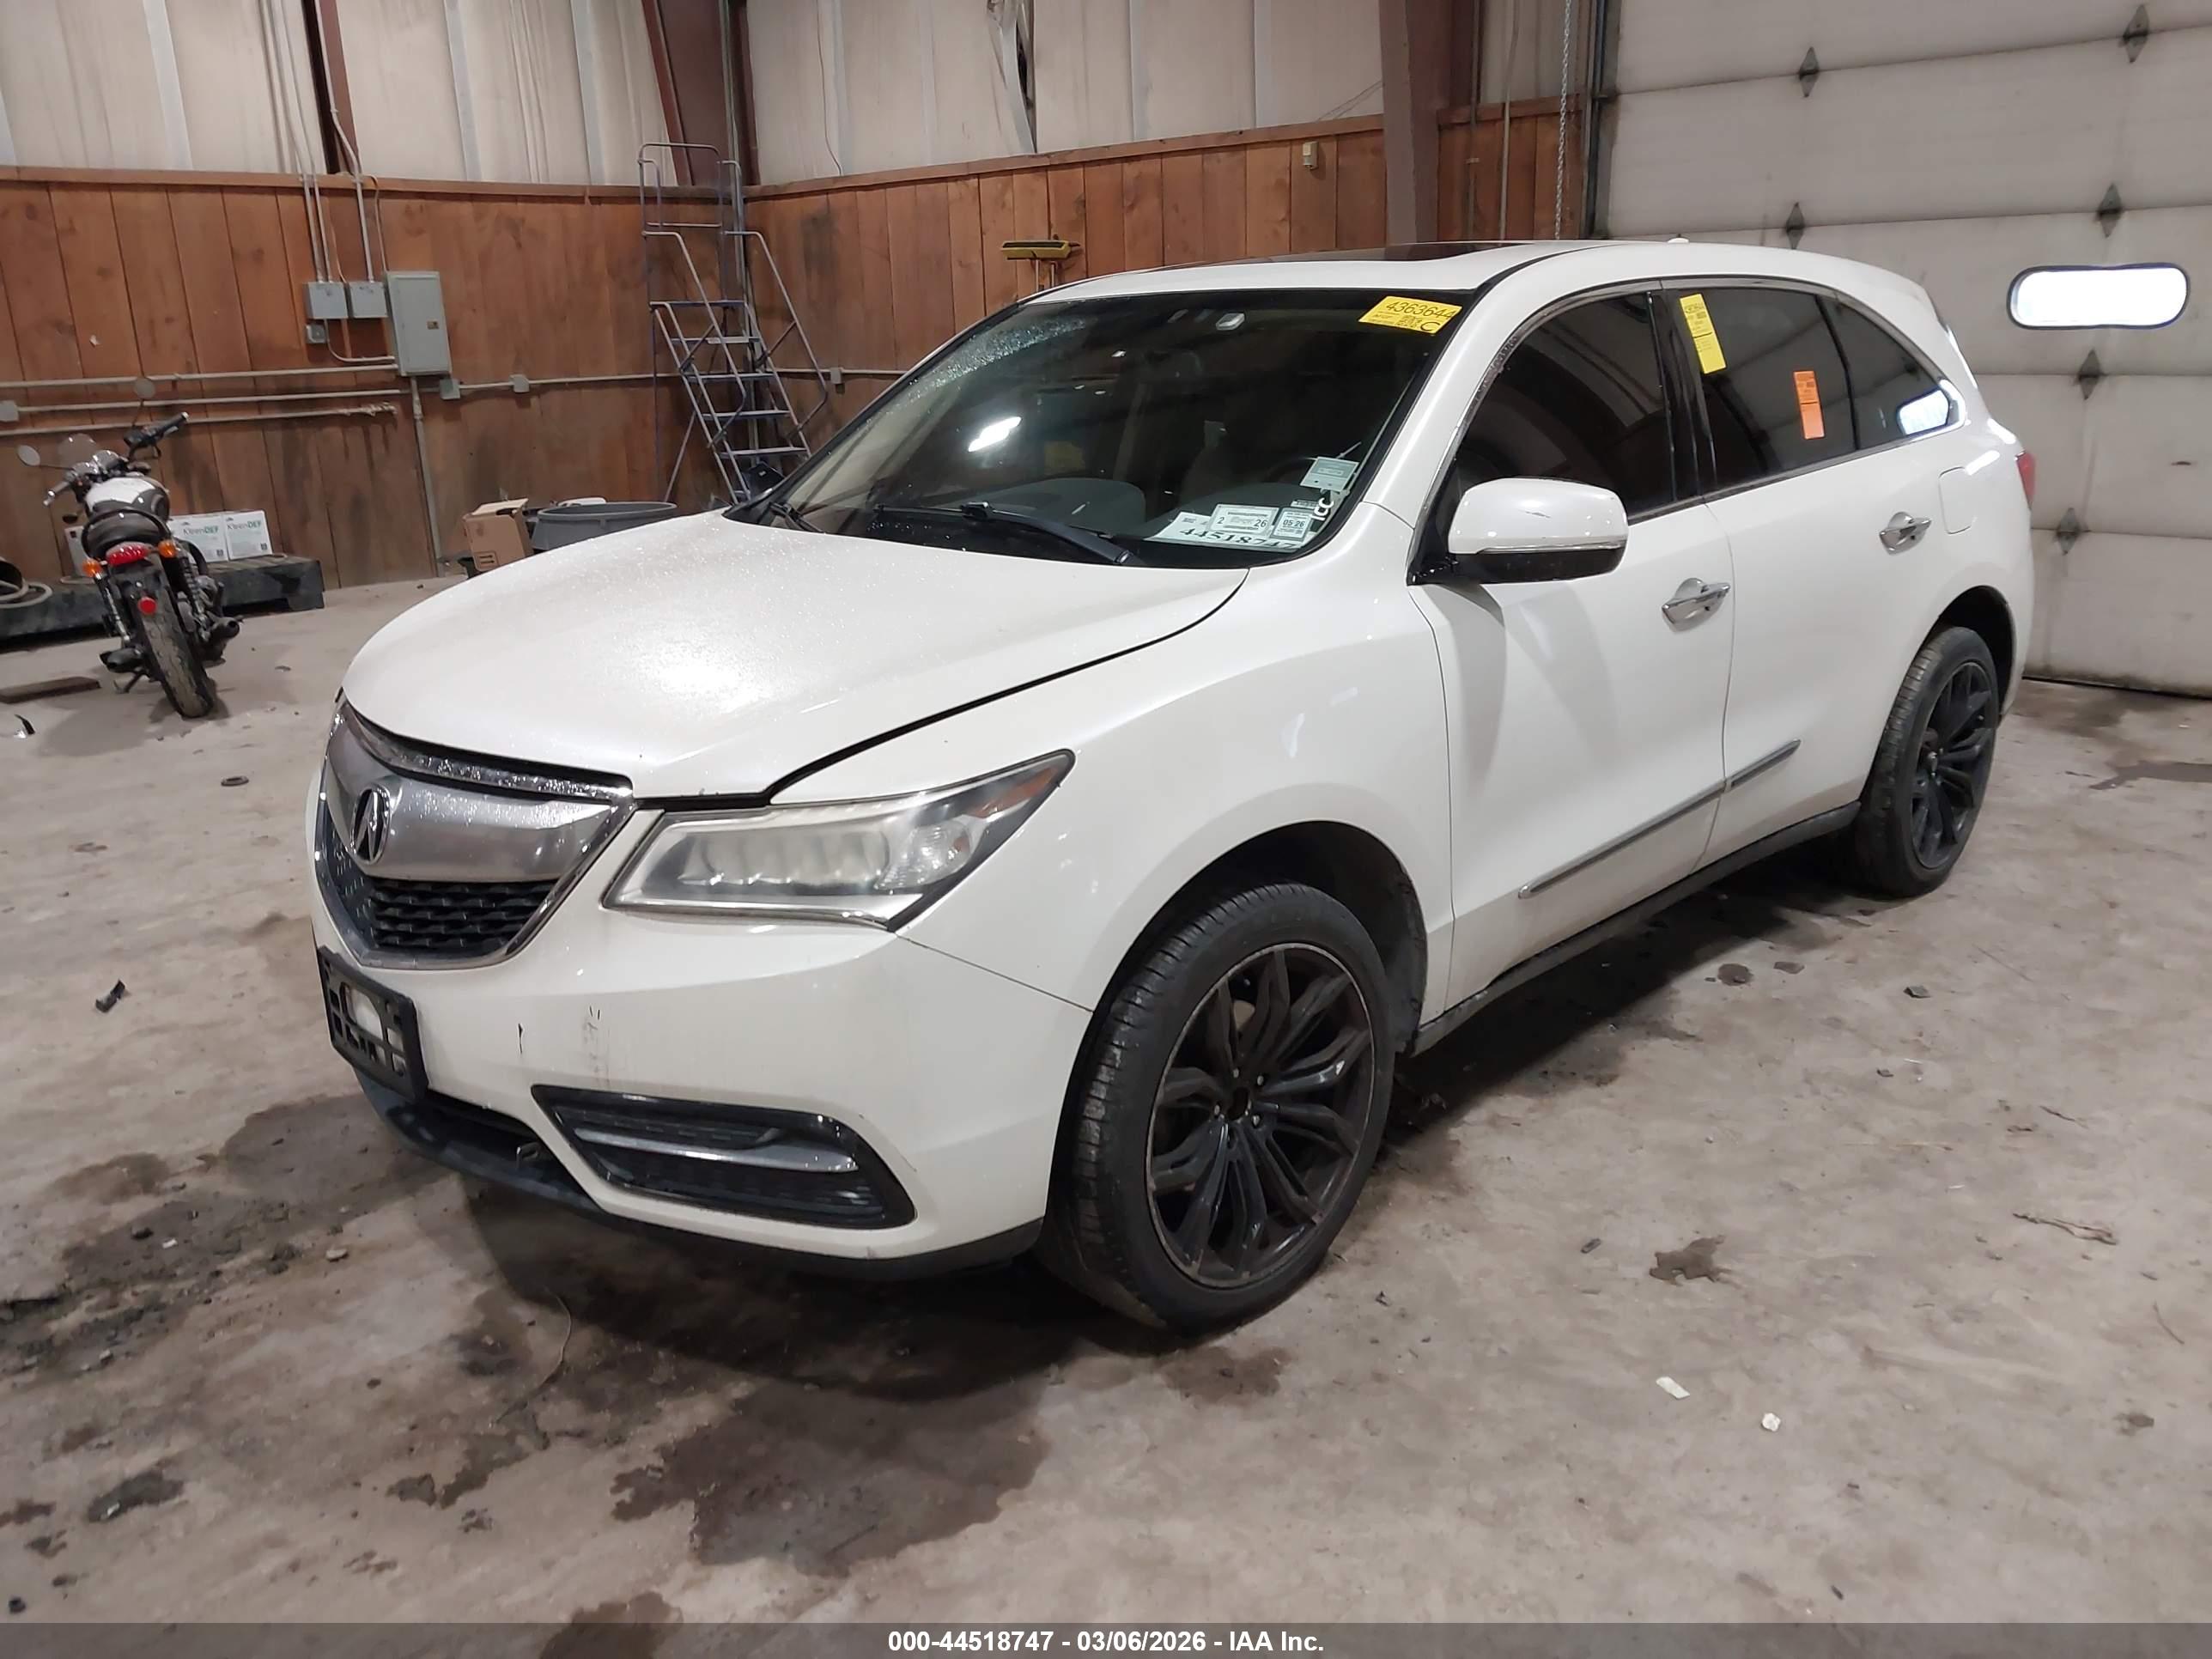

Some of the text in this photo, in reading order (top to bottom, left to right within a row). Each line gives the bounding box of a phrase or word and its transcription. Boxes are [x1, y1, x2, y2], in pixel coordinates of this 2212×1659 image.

[1387, 301, 1456, 319] 4363644
[1254, 519, 1267, 528] 26
[1282, 518, 1305, 528] 05 26
[1180, 528, 1297, 549] 44518747
